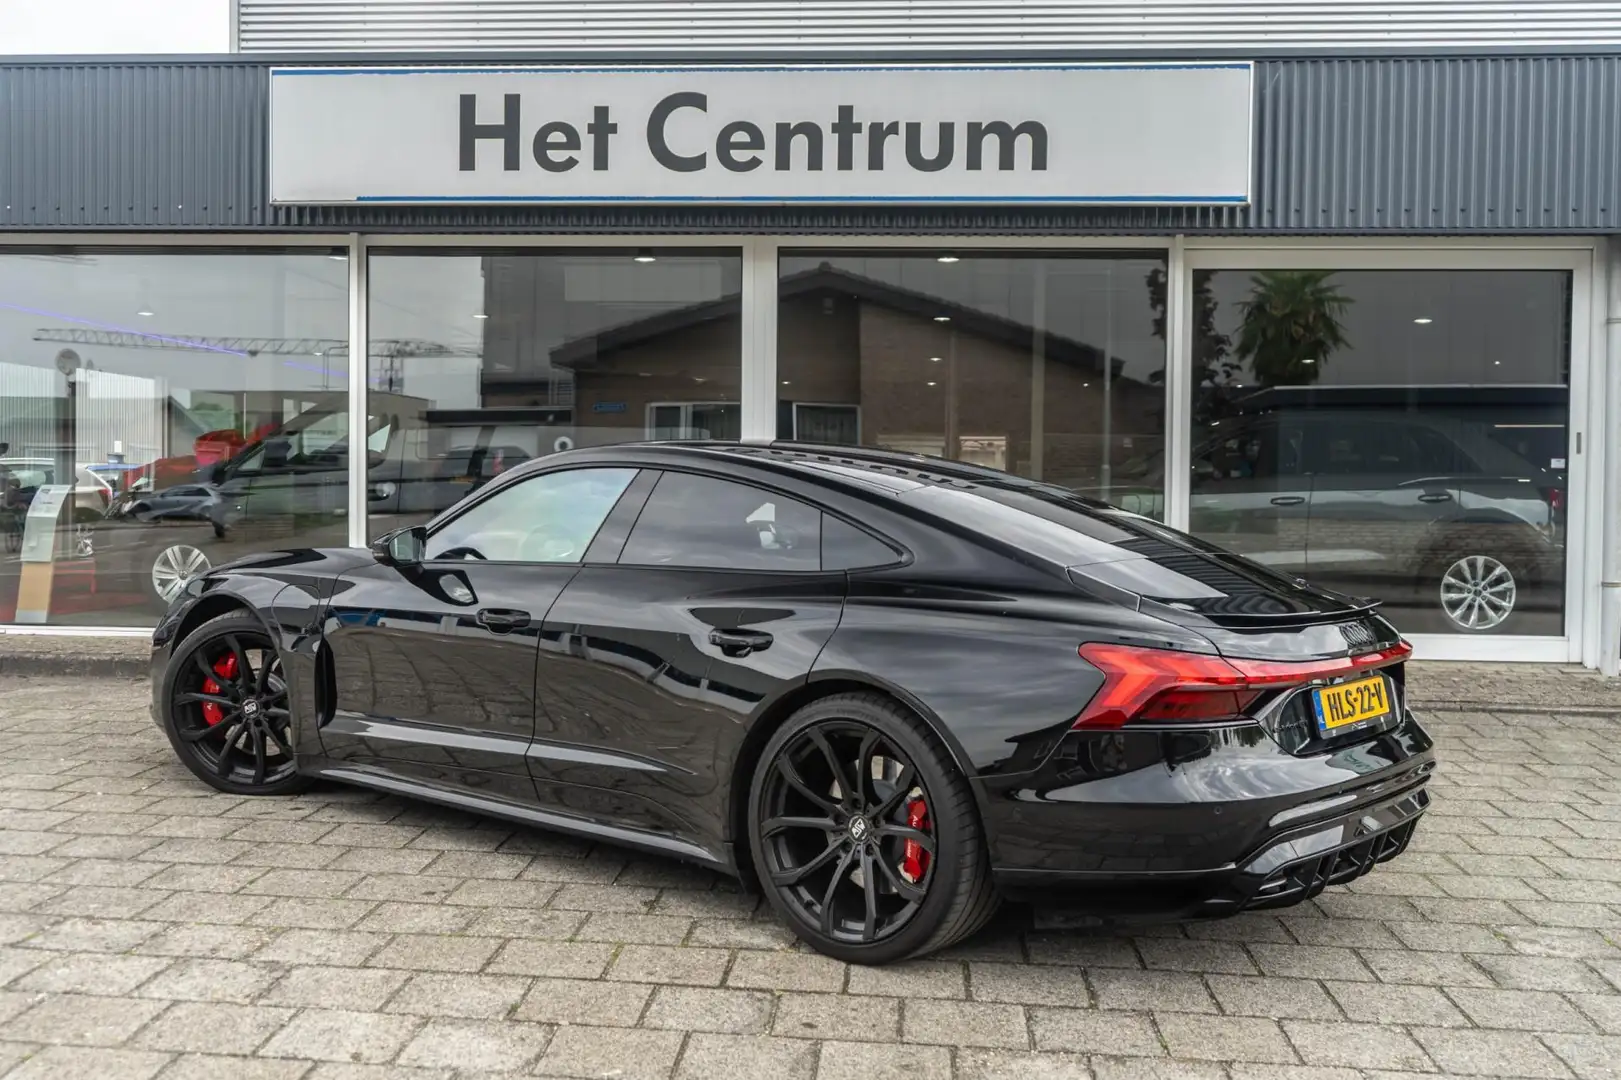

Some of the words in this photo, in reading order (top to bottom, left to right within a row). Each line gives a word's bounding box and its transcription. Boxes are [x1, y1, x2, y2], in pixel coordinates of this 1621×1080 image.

[460, 94, 618, 172] Het
[647, 92, 1048, 173] Centrum
[1327, 682, 1384, 722] HLS-22-V
